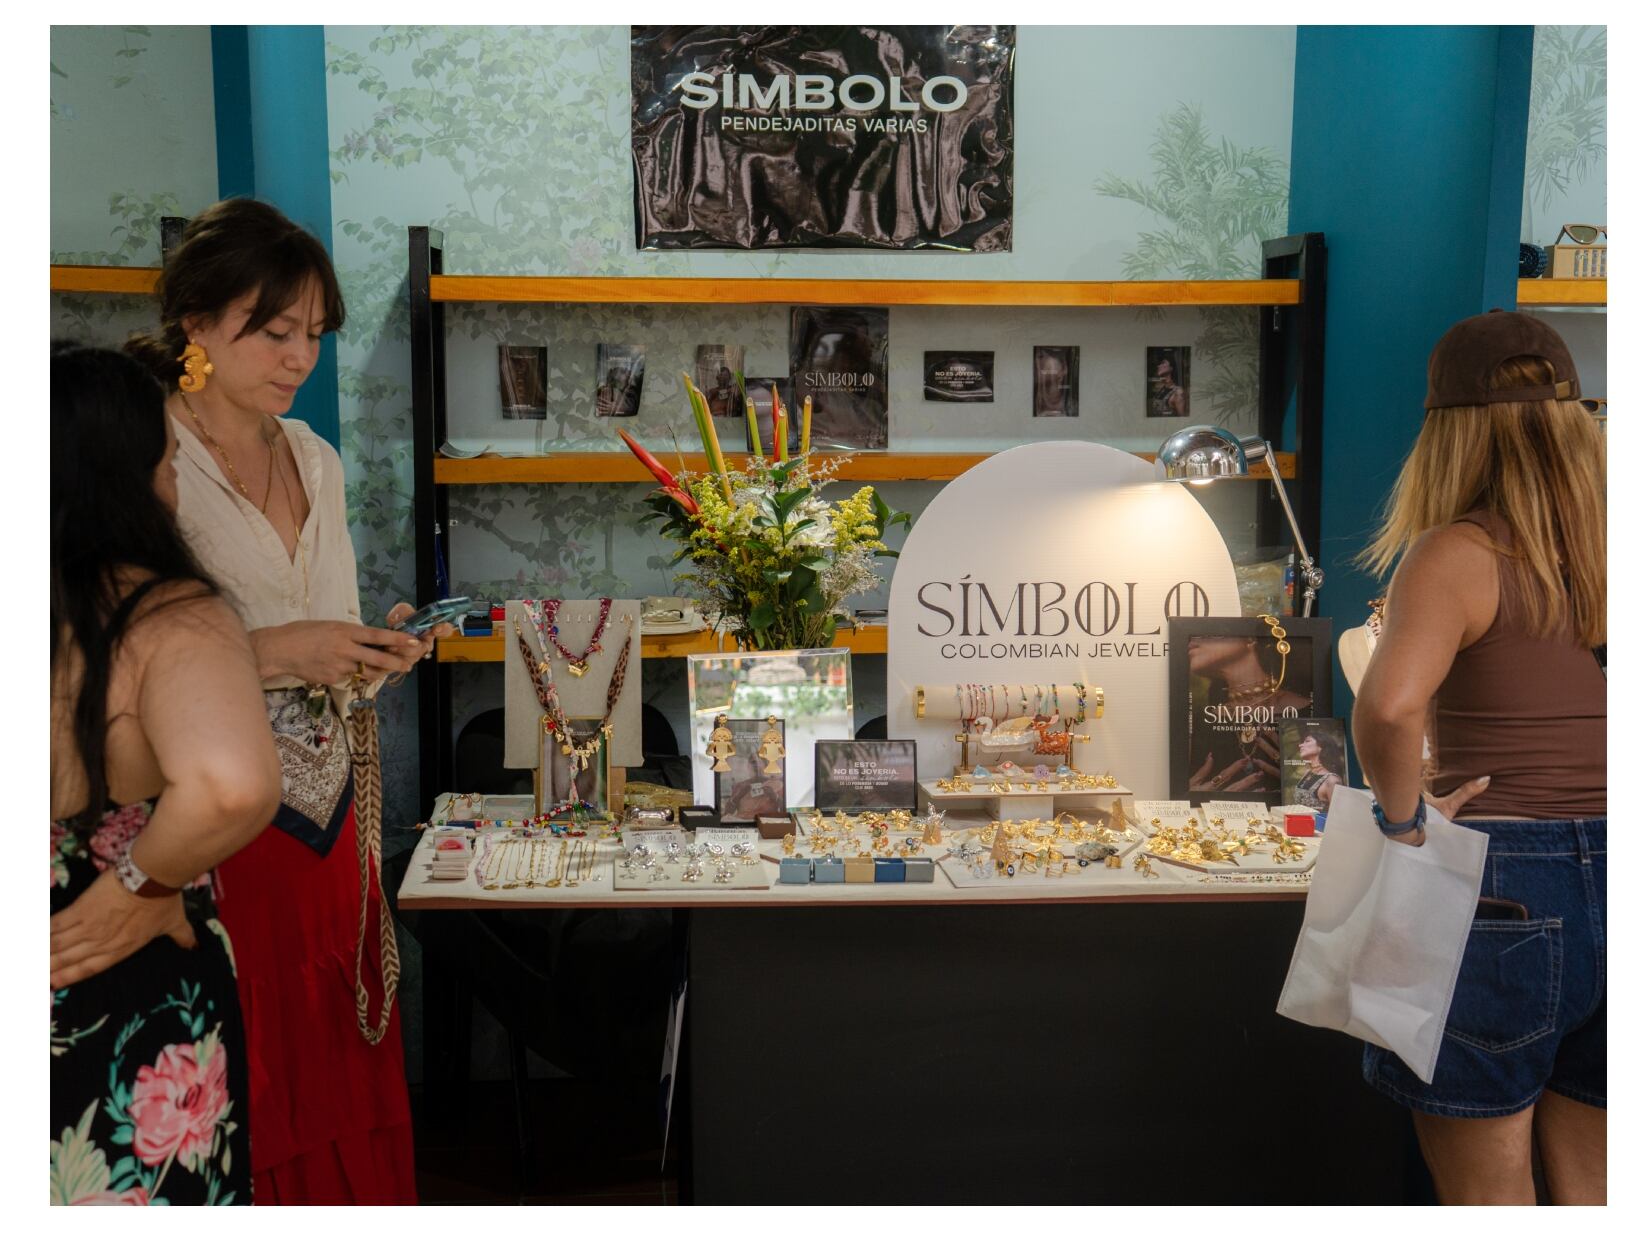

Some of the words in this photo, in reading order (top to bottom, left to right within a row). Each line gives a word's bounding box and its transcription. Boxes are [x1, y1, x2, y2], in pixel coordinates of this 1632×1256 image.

[721, 116, 857, 132] PENDEJADITAS
[862, 118, 929, 133] VARIAS
[805, 371, 875, 387] SÍMBOLO
[917, 574, 1210, 637] SÍMBOLO
[941, 642, 1080, 659] COLOMBIAN
[1203, 703, 1299, 724] SÍMBOLO
